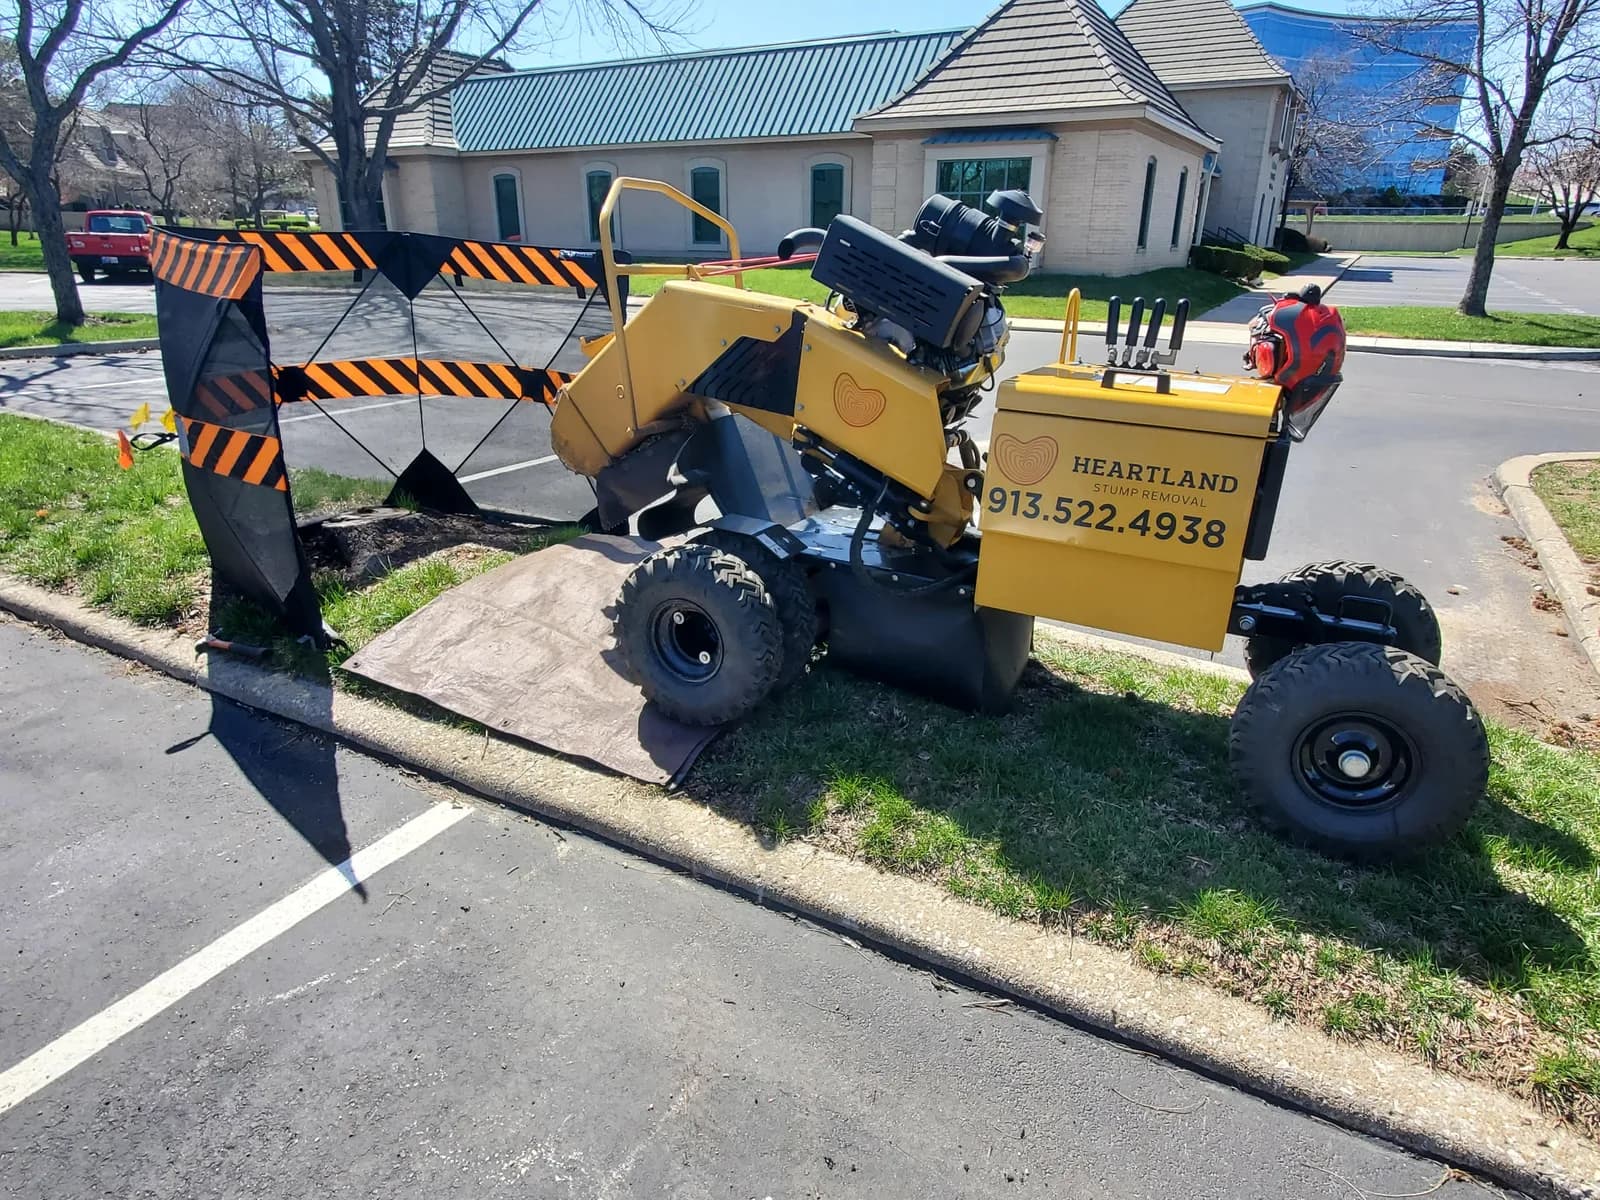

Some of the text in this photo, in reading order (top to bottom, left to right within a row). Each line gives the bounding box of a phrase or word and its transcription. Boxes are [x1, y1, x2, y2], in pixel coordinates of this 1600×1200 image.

[1072, 455, 1239, 493] HEARTLAND
[1092, 483, 1208, 508] STUMP REMOVAL
[987, 487, 1226, 549] 913.522.4938
